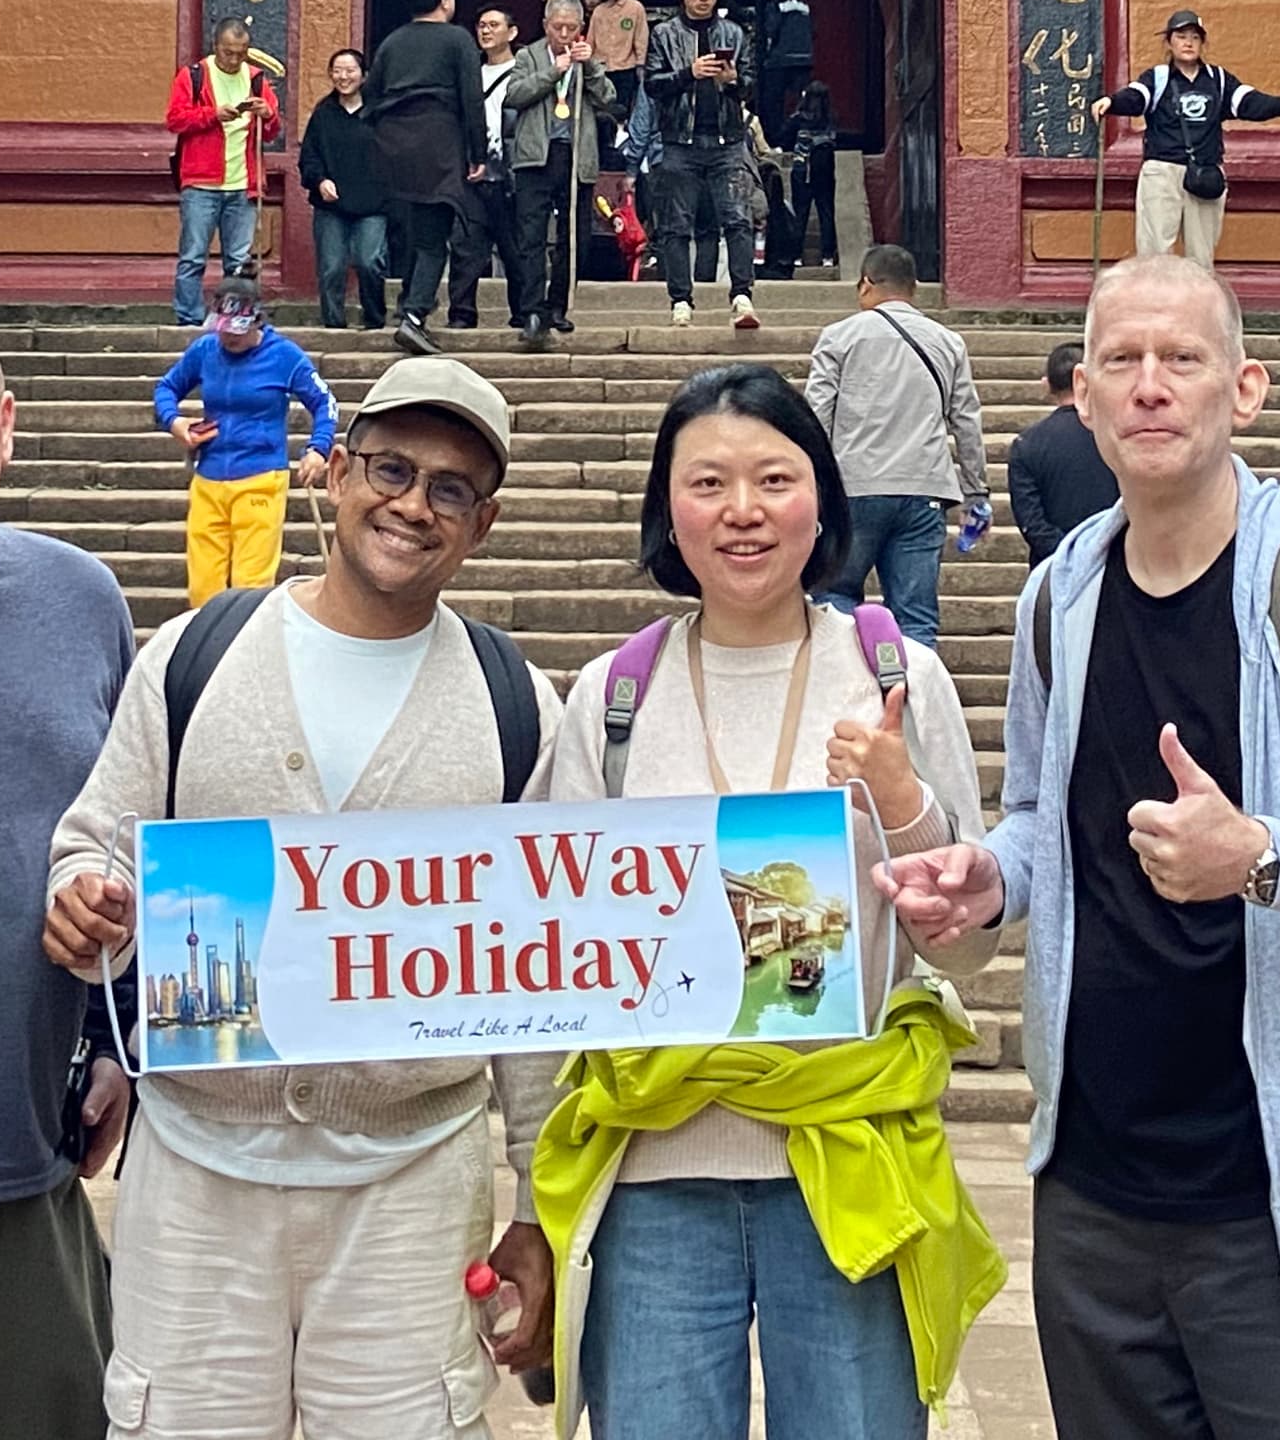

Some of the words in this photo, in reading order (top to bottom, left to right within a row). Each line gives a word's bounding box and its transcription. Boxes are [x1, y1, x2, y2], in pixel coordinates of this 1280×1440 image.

[282, 843, 492, 912] Your
[514, 831, 706, 916] Way
[330, 919, 668, 1010] Holiday
[408, 1020, 465, 1041] Travel
[468, 1017, 509, 1037] Like
[512, 1015, 534, 1036] A
[536, 1013, 588, 1034] Local
